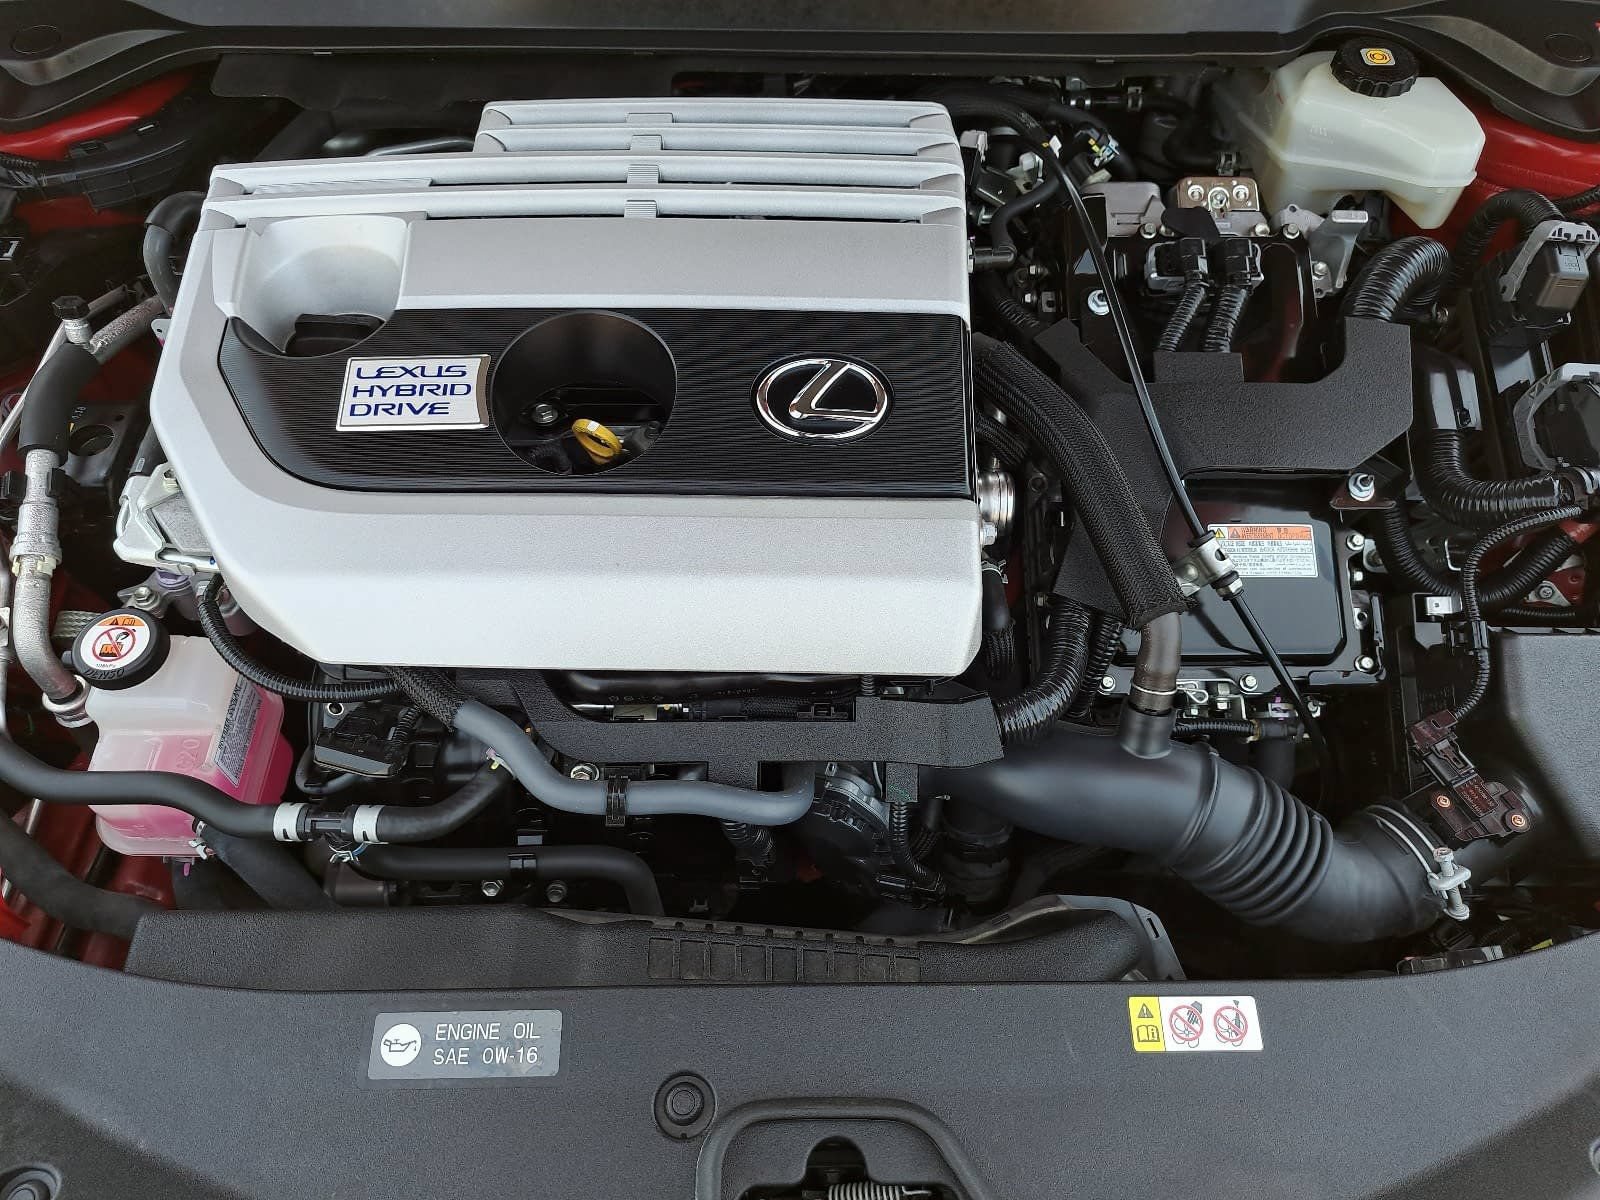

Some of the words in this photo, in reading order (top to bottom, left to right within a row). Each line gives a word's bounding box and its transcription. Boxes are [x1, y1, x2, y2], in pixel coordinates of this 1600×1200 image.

[356, 365, 468, 380] LEXUS
[352, 383, 472, 398] HYBRID
[349, 402, 450, 417] DRIVE
[83, 667, 125, 680] DENSO
[435, 1022, 501, 1041] ENGINE
[513, 1022, 540, 1039] OIL
[433, 1048, 470, 1065] SAE
[482, 1046, 538, 1064] 0W-16
